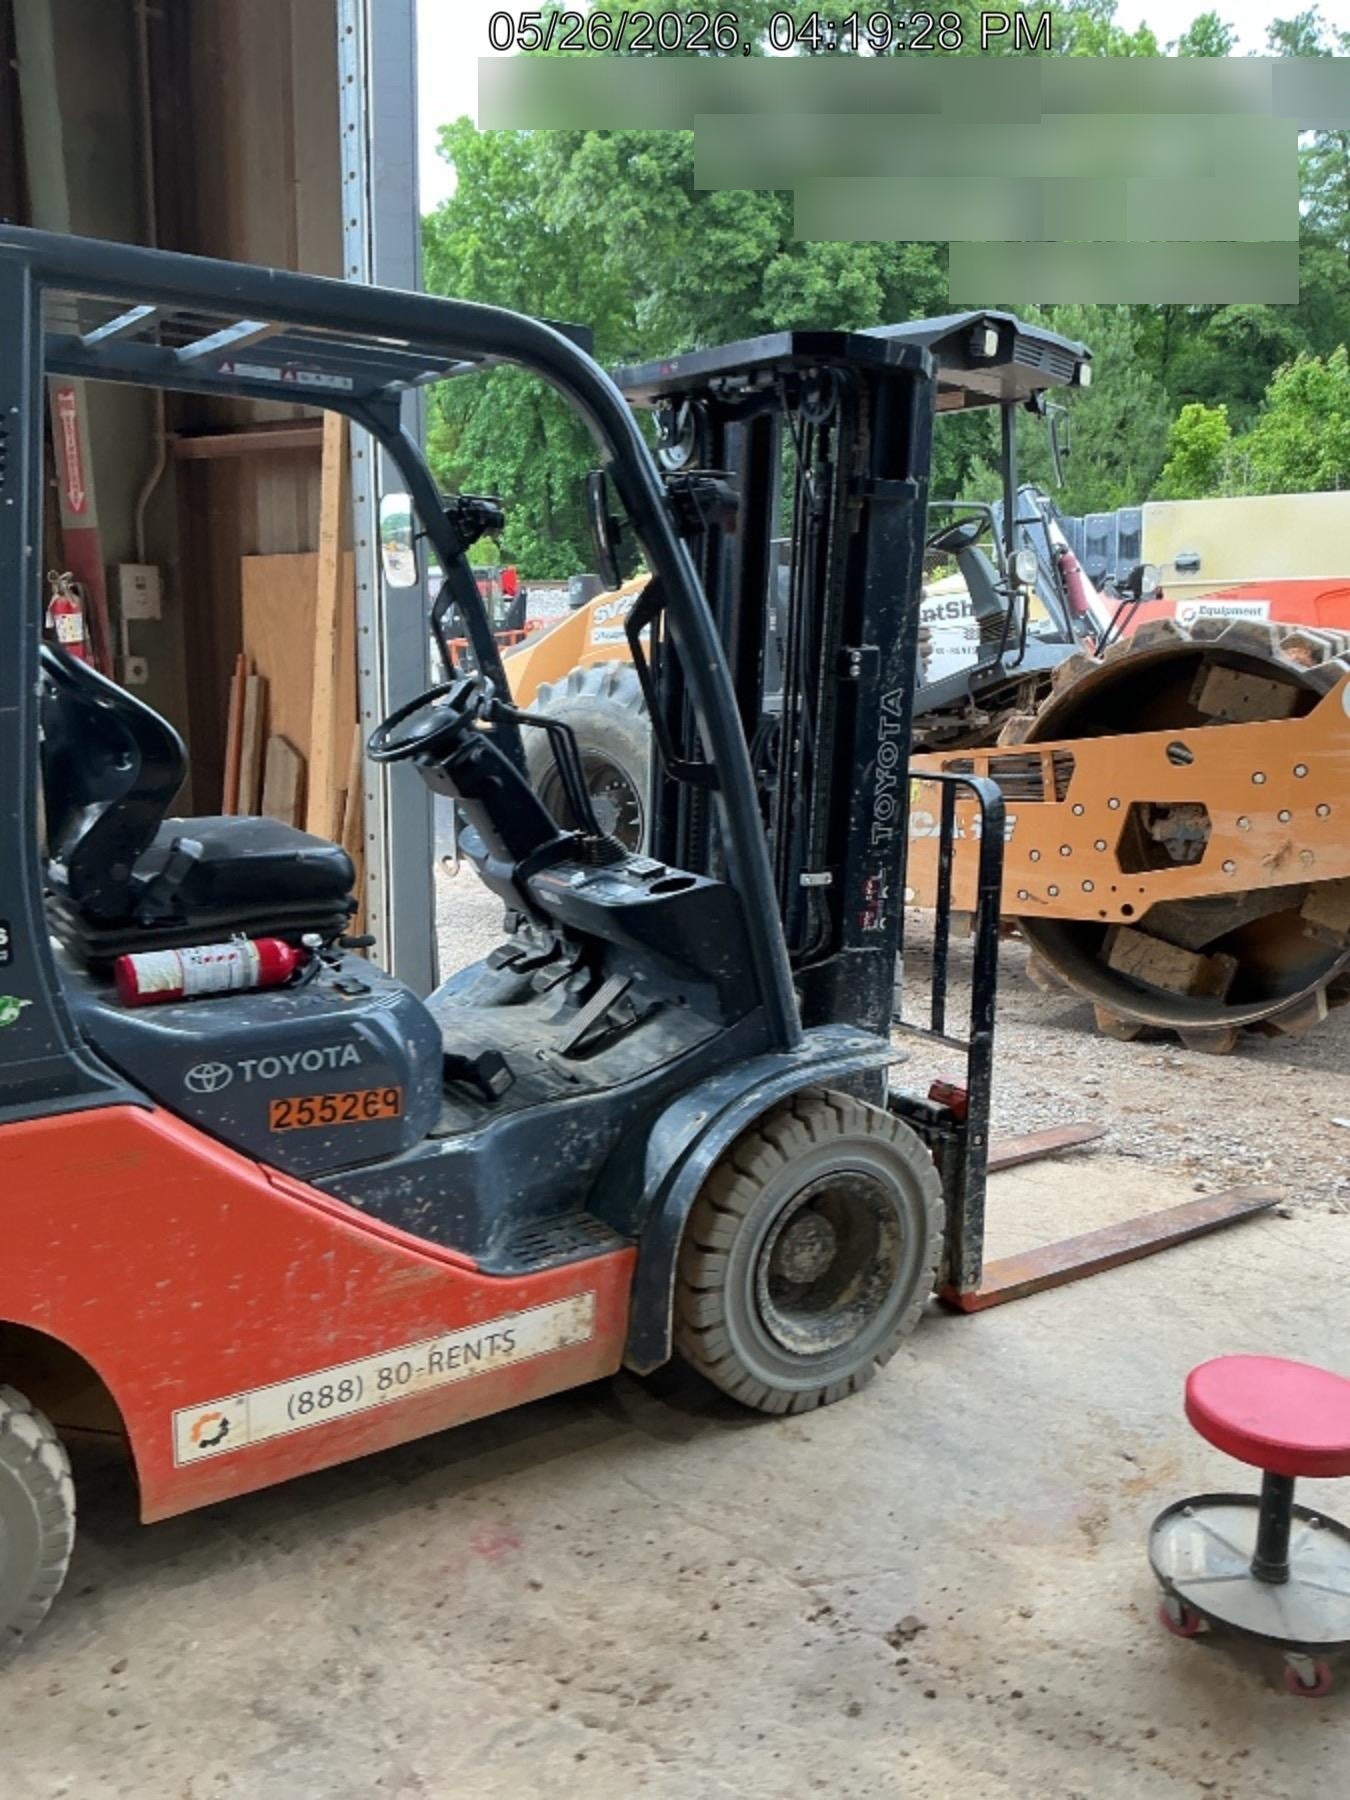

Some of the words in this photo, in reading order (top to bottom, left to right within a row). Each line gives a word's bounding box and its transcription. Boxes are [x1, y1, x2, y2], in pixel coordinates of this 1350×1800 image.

[1199, 605, 1262, 617] Equipment
[871, 688, 905, 846] TOYOTA
[238, 1044, 362, 1083] TOYOTA
[273, 1089, 400, 1129] 255269
[286, 1375, 364, 1421] (888)
[376, 1329, 516, 1392] 80-RENTS
